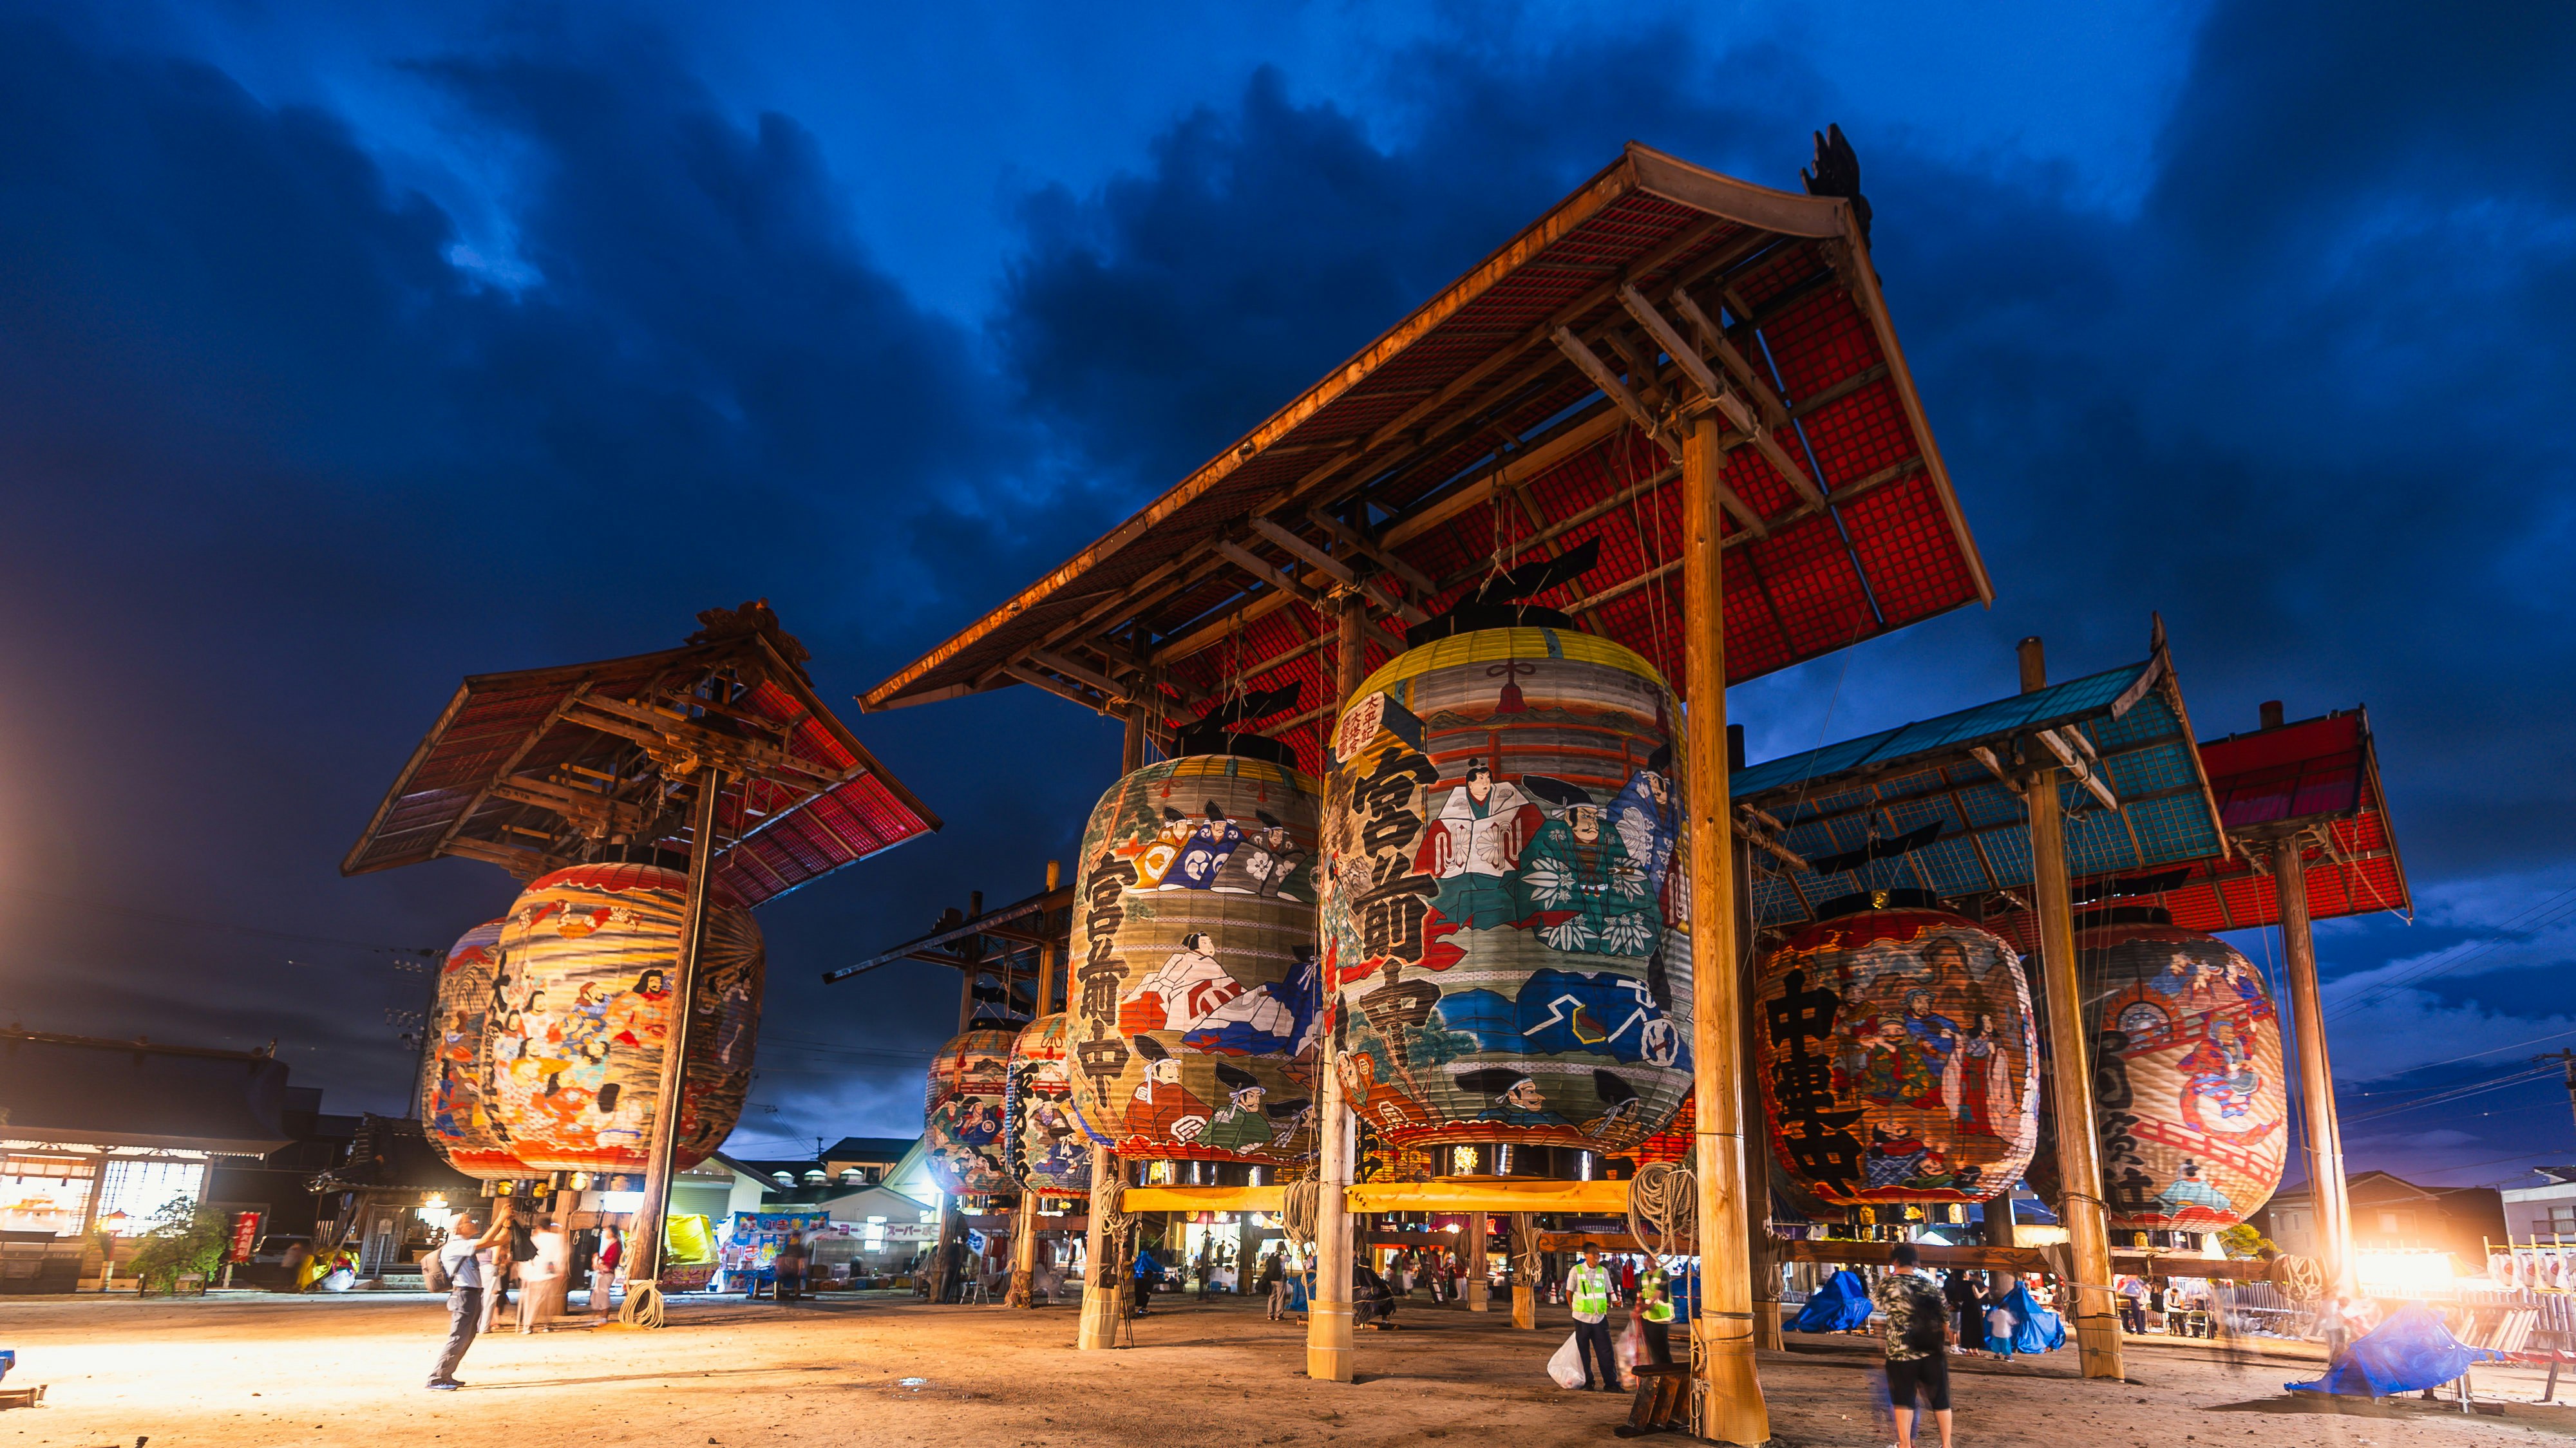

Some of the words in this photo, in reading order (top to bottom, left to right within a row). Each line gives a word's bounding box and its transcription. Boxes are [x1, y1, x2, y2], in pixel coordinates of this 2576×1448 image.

[1361, 696, 1379, 744] 太平記
[1077, 851, 1139, 1108] 宮前中
[1351, 746, 1443, 1069] 宮前中
[761, 1218, 804, 1230] かき氷
